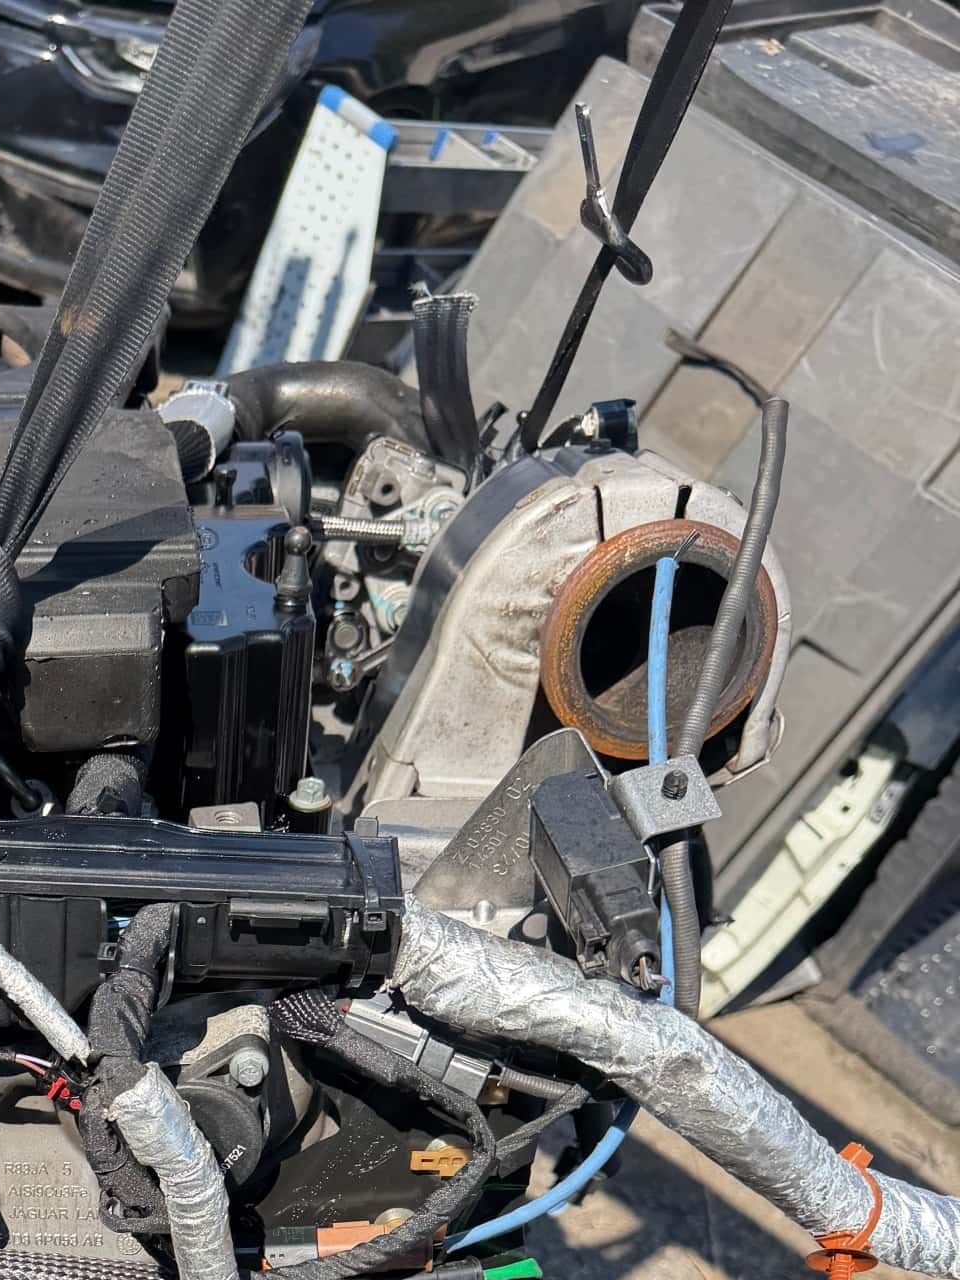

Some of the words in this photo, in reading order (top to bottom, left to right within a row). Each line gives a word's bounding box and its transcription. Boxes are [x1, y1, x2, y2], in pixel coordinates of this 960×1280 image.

[61, 1161, 73, 1178] 5
[8, 1205, 70, 1221] JAGUAR
[76, 1206, 101, 1221] LA
